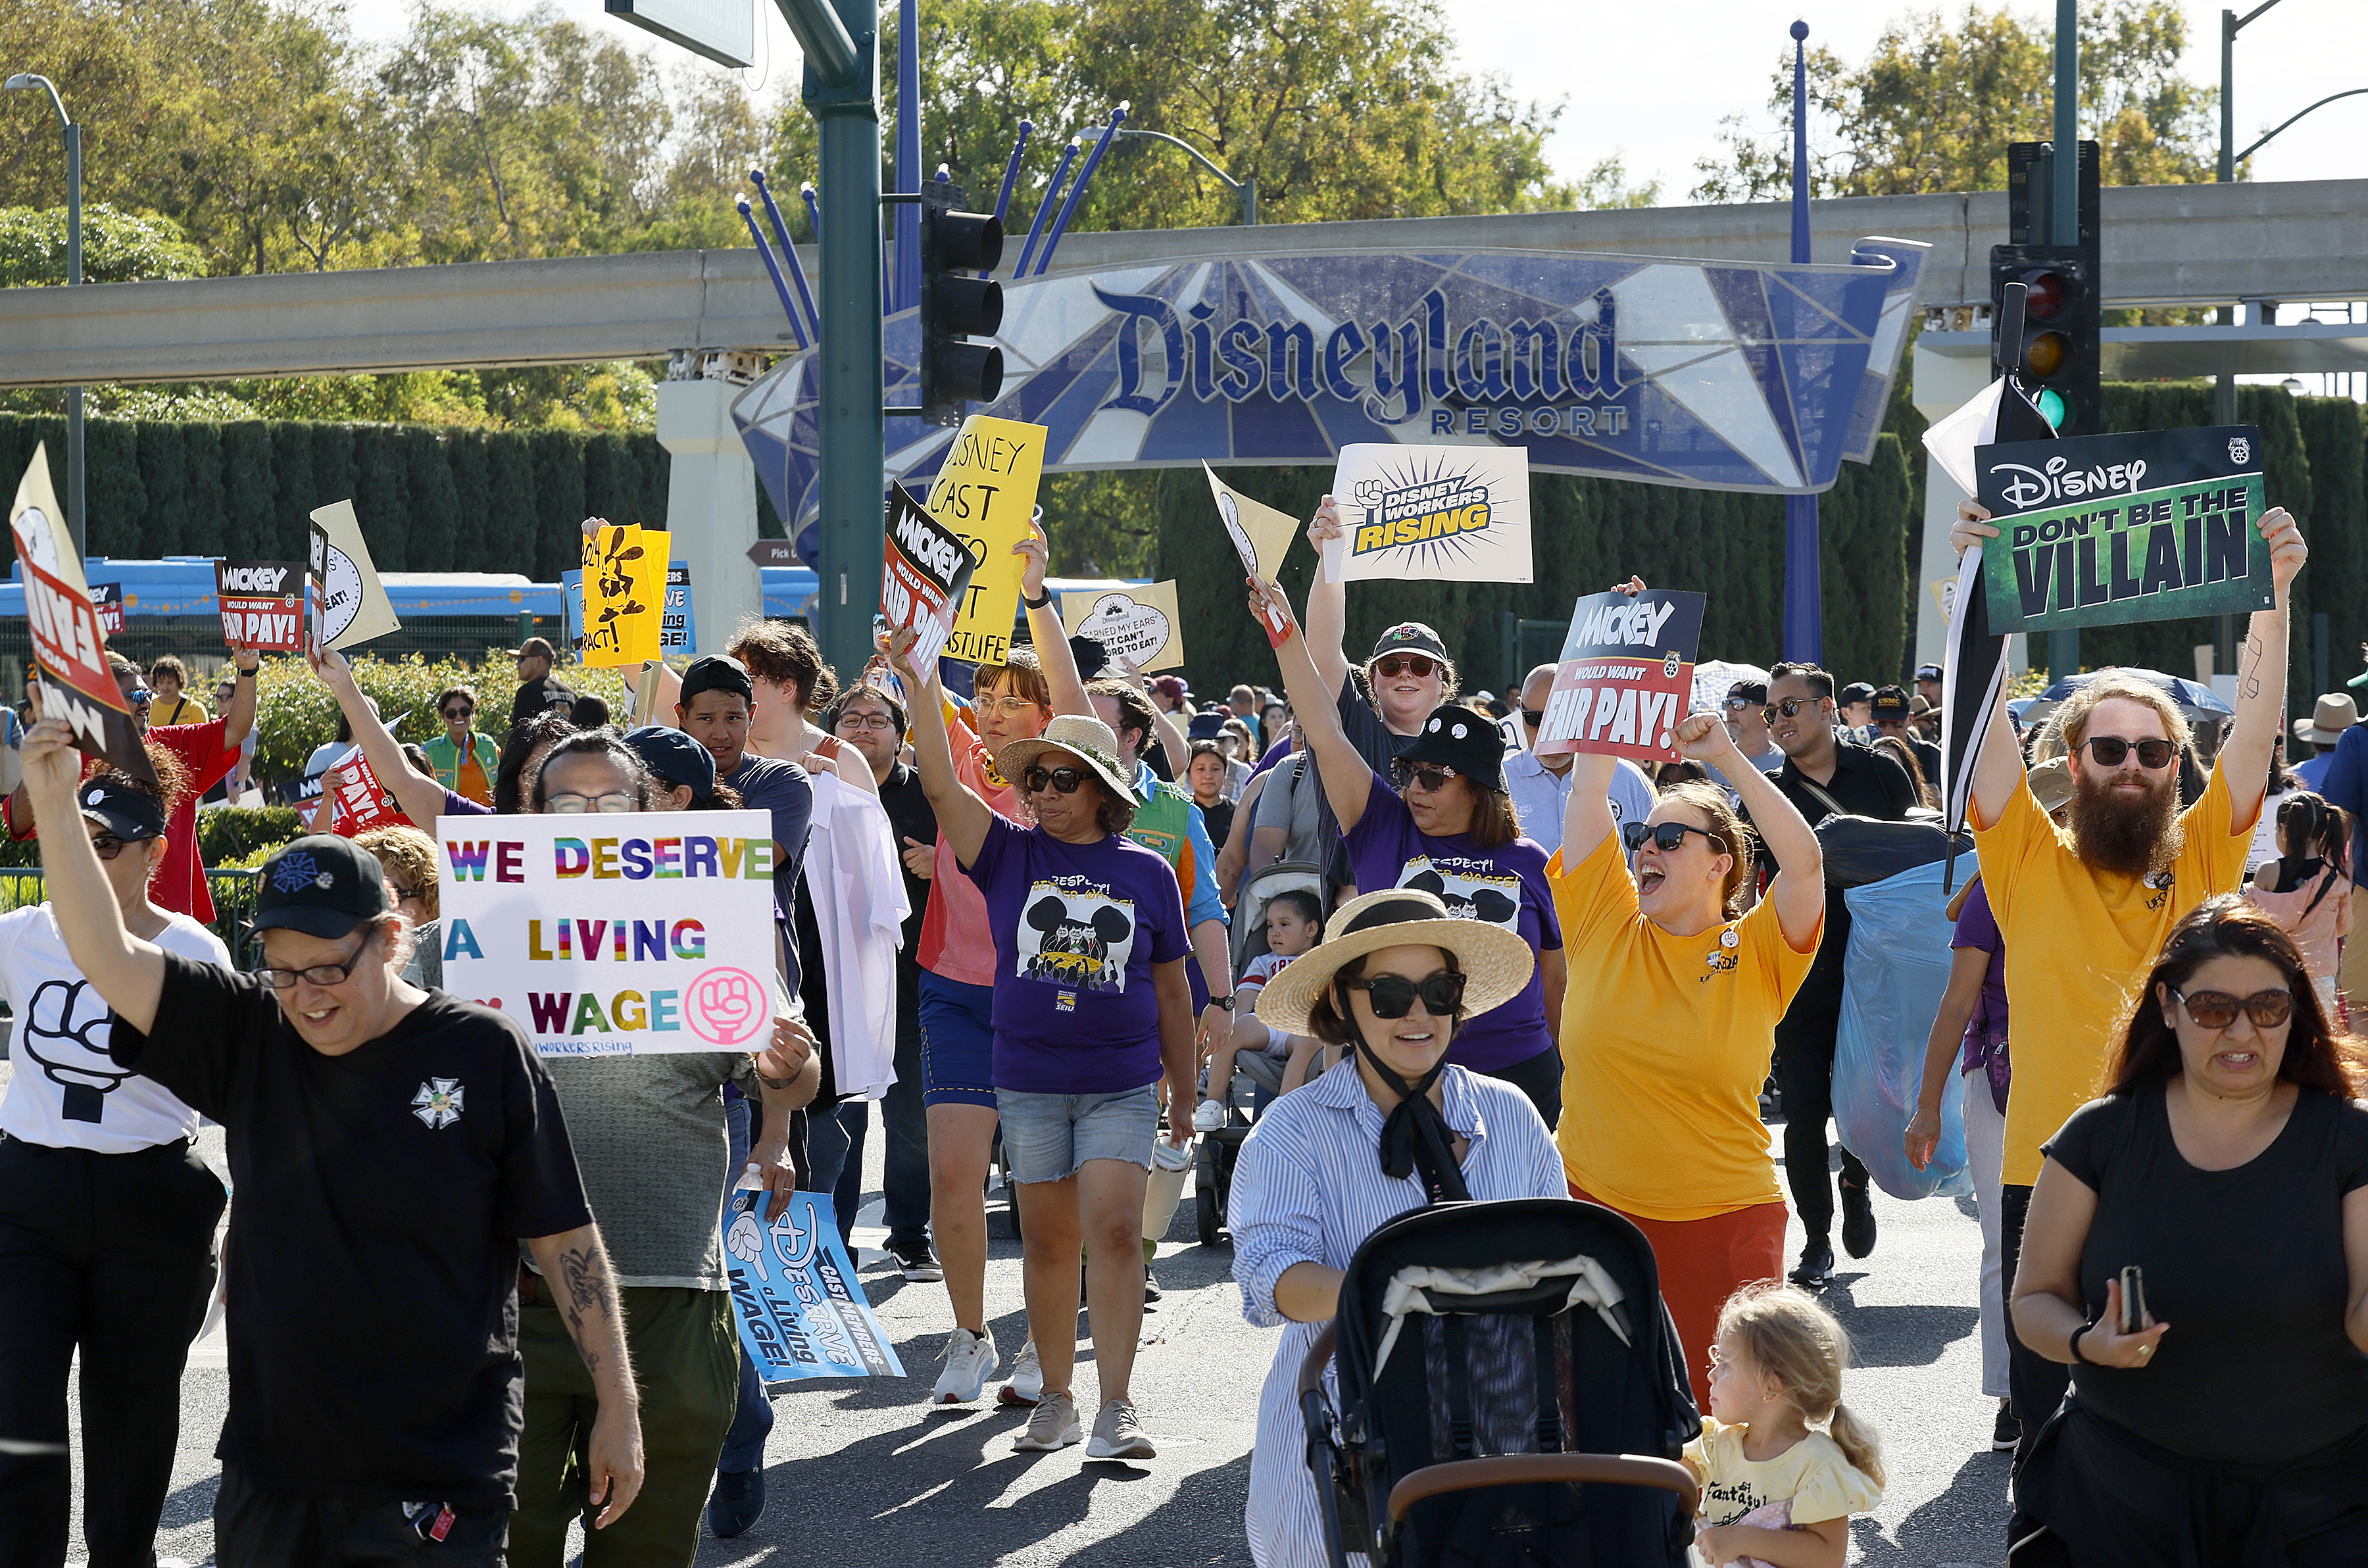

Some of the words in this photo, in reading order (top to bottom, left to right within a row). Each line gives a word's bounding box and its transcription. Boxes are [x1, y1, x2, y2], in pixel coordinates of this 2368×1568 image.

[1089, 278, 1629, 426] Disneyland
[1431, 405, 1627, 436] RESORT
[931, 478, 1000, 521] CAST
[1385, 489, 1487, 521] WORKERS
[1386, 479, 1463, 508] DISNEY
[1356, 504, 1489, 552] RISING
[2013, 508, 2121, 549] DON'T
[2128, 499, 2173, 528] BE
[2181, 487, 2248, 518] THE
[772, 548, 789, 558] Pick
[896, 504, 964, 587] MICKEY
[2013, 510, 2249, 618] VILLAIN
[222, 566, 288, 593] MICKEY
[896, 559, 922, 591] WOULD
[921, 583, 943, 611] WANT
[227, 600, 248, 609] WOULD
[882, 561, 911, 629] FAIR
[912, 599, 946, 672] PAY!
[1575, 600, 1675, 648] MICKEY
[246, 613, 296, 645] PAY!
[1117, 630, 1145, 644] CAN'T
[1118, 623, 1131, 634] MY
[1126, 644, 1138, 653] TO
[1139, 636, 1158, 649] EAT!
[1574, 665, 1606, 681] WOULD
[1607, 665, 1646, 681] WANT
[1540, 687, 1594, 743] FAIR
[1589, 687, 1679, 750] PAY!
[340, 765, 380, 823] PAY!
[360, 763, 378, 789] WANT
[446, 840, 525, 883] WE
[555, 835, 774, 880] DESERVE
[1459, 871, 1521, 888] WAGES!
[443, 918, 485, 960] A
[528, 918, 706, 962] LIVING
[528, 989, 681, 1036] WAGE
[763, 1286, 777, 1297] a
[728, 1269, 792, 1367] WAGE!
[768, 1296, 819, 1365] Living
[820, 1265, 849, 1304] CAST
[837, 1302, 884, 1365] MEMBERS
